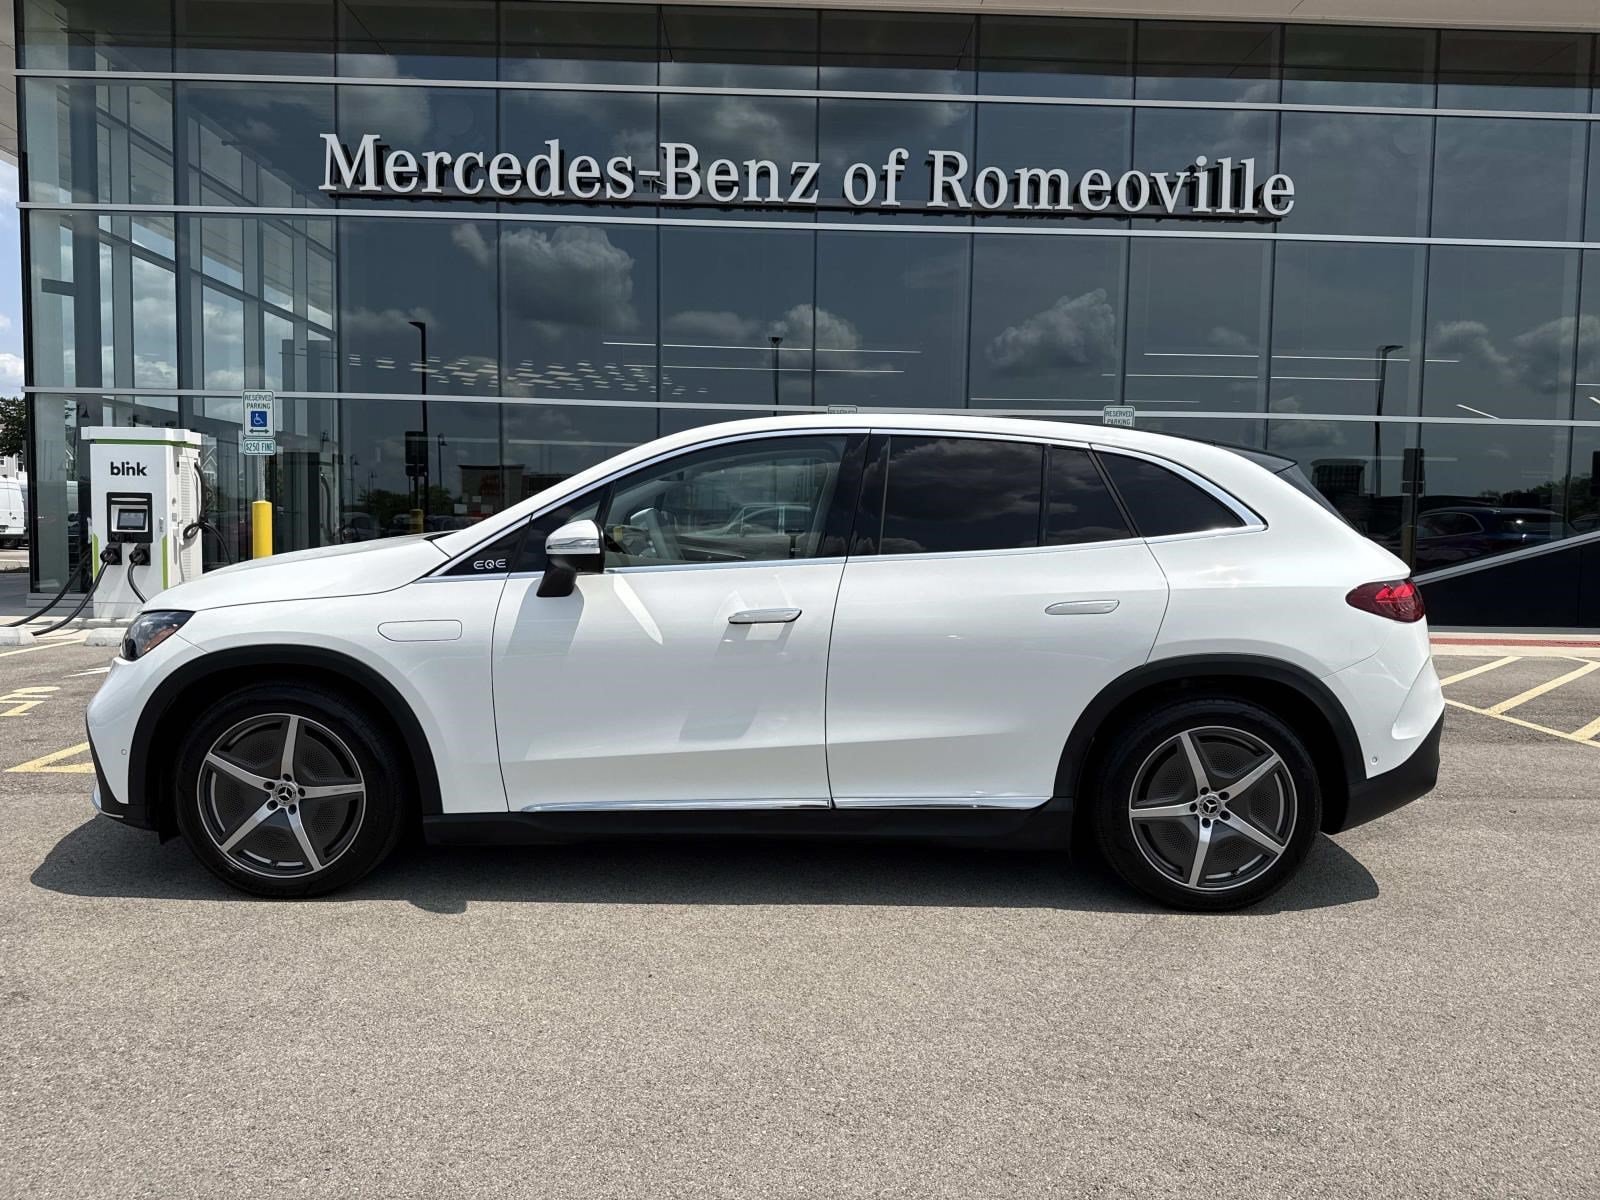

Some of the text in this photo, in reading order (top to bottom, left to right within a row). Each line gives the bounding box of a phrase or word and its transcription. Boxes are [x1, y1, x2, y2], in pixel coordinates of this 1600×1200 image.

[318, 132, 1296, 216] Mercedes-Benz of Romeoville
[245, 442, 273, 452] $250 FINE
[110, 461, 148, 477] blink
[474, 558, 506, 570] EQE
